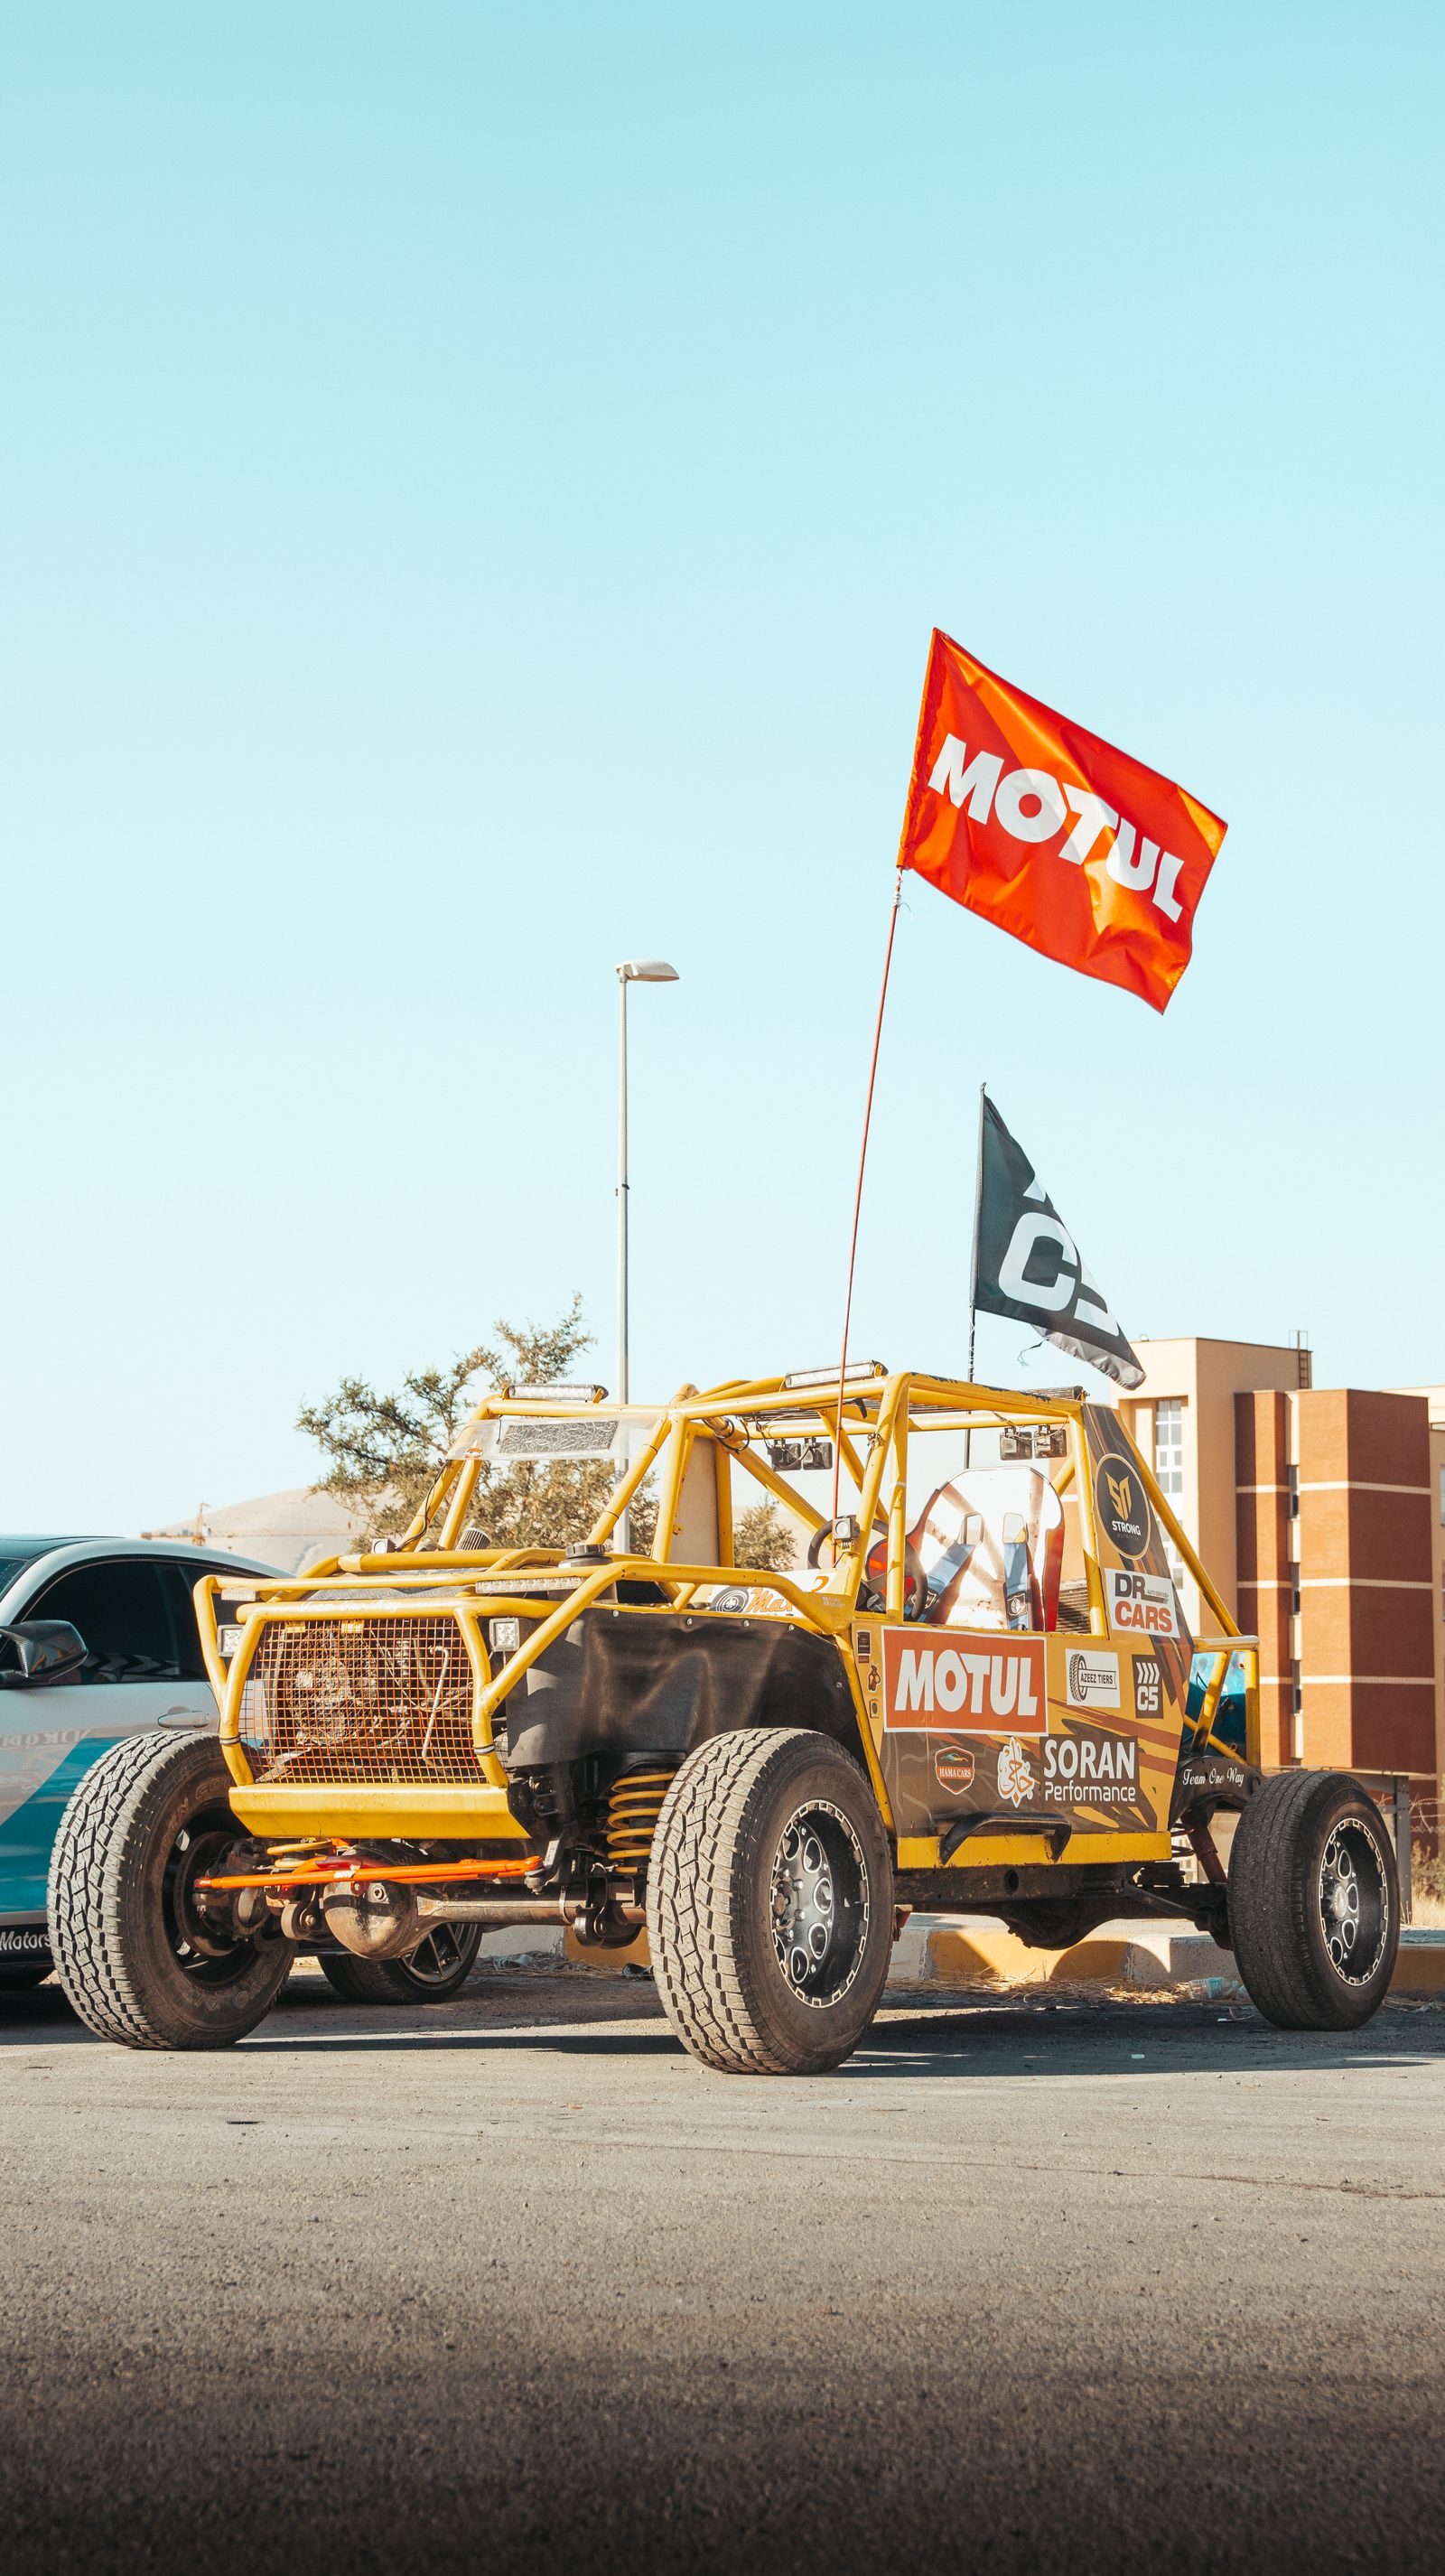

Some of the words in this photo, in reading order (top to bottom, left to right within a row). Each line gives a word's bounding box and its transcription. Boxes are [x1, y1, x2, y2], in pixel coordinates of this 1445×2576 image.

[928, 733, 1184, 923] MOTUL
[1112, 1520, 1142, 1535] STRONG
[1114, 1573, 1146, 1600] DR
[1114, 1601, 1173, 1634] CARS
[894, 1648, 1039, 1716] MOTUL
[1080, 1673, 1097, 1684] AZEEZ
[1097, 1675, 1114, 1685] TIERS
[1137, 1685, 1159, 1711] C5
[1044, 1739, 1135, 1779] SORAN
[939, 1768, 957, 1778] HAMA
[957, 1769, 972, 1778] CARS
[1182, 1769, 1206, 1786] Team
[1208, 1768, 1225, 1785] One
[1226, 1767, 1245, 1787] Way
[1045, 1779, 1136, 1802] Performance
[0, 1930, 51, 1951] Motors
